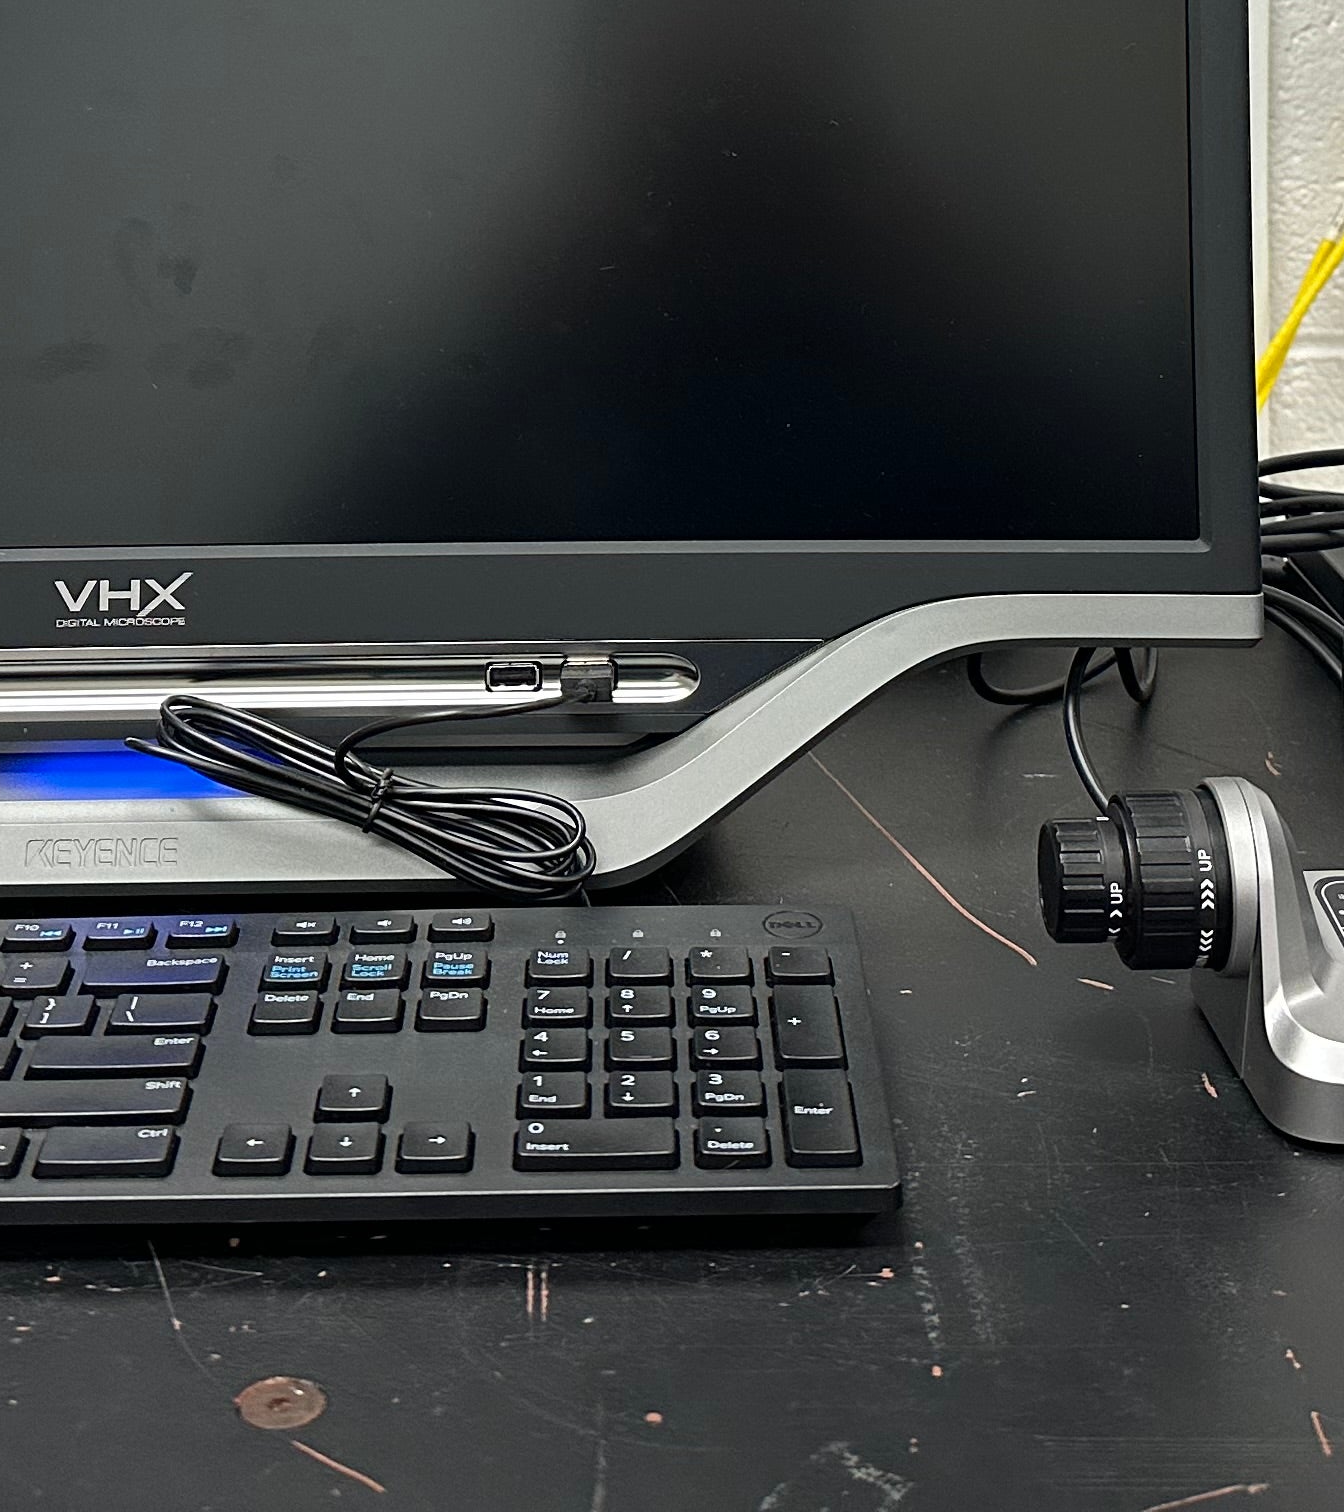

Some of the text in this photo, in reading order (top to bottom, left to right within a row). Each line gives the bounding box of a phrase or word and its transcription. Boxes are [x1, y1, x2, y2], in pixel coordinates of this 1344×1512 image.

[54, 571, 194, 617] VHX
[55, 616, 187, 629] DIGITAL MICROSCOPE
[23, 837, 179, 868] KEYENCE
[1197, 849, 1213, 872] UP
[1109, 882, 1124, 905] UP
[14, 924, 40, 932] F10
[96, 922, 119, 930] F11
[179, 920, 204, 928] F12
[274, 955, 315, 964] Insert
[354, 953, 395, 962] Home
[435, 952, 472, 961] PgUp
[146, 957, 218, 967] Backspace
[434, 962, 474, 970] Pause
[271, 965, 306, 973] Print
[264, 993, 310, 1003] Delete
[346, 992, 375, 1001] End
[429, 991, 469, 1001] PgDn
[536, 989, 551, 1000] 7
[620, 988, 635, 999] 8
[701, 988, 717, 999] 9
[534, 1006, 575, 1014] Home
[699, 1006, 737, 1014] PgUp
[533, 1031, 549, 1042] 4
[620, 1030, 635, 1042] 5
[704, 1029, 720, 1041] 6
[153, 1037, 195, 1046] Enter
[532, 1075, 543, 1087] 1
[620, 1074, 636, 1086] 2
[708, 1073, 723, 1085] 3
[145, 1080, 182, 1090] Shift
[528, 1094, 557, 1103] End
[705, 1093, 744, 1103] PgDn
[794, 1106, 833, 1114] Enter
[527, 1122, 545, 1134] 0
[137, 1128, 169, 1139] Ctrl
[525, 1142, 570, 1151] Insert
[707, 1140, 755, 1150] Delete
